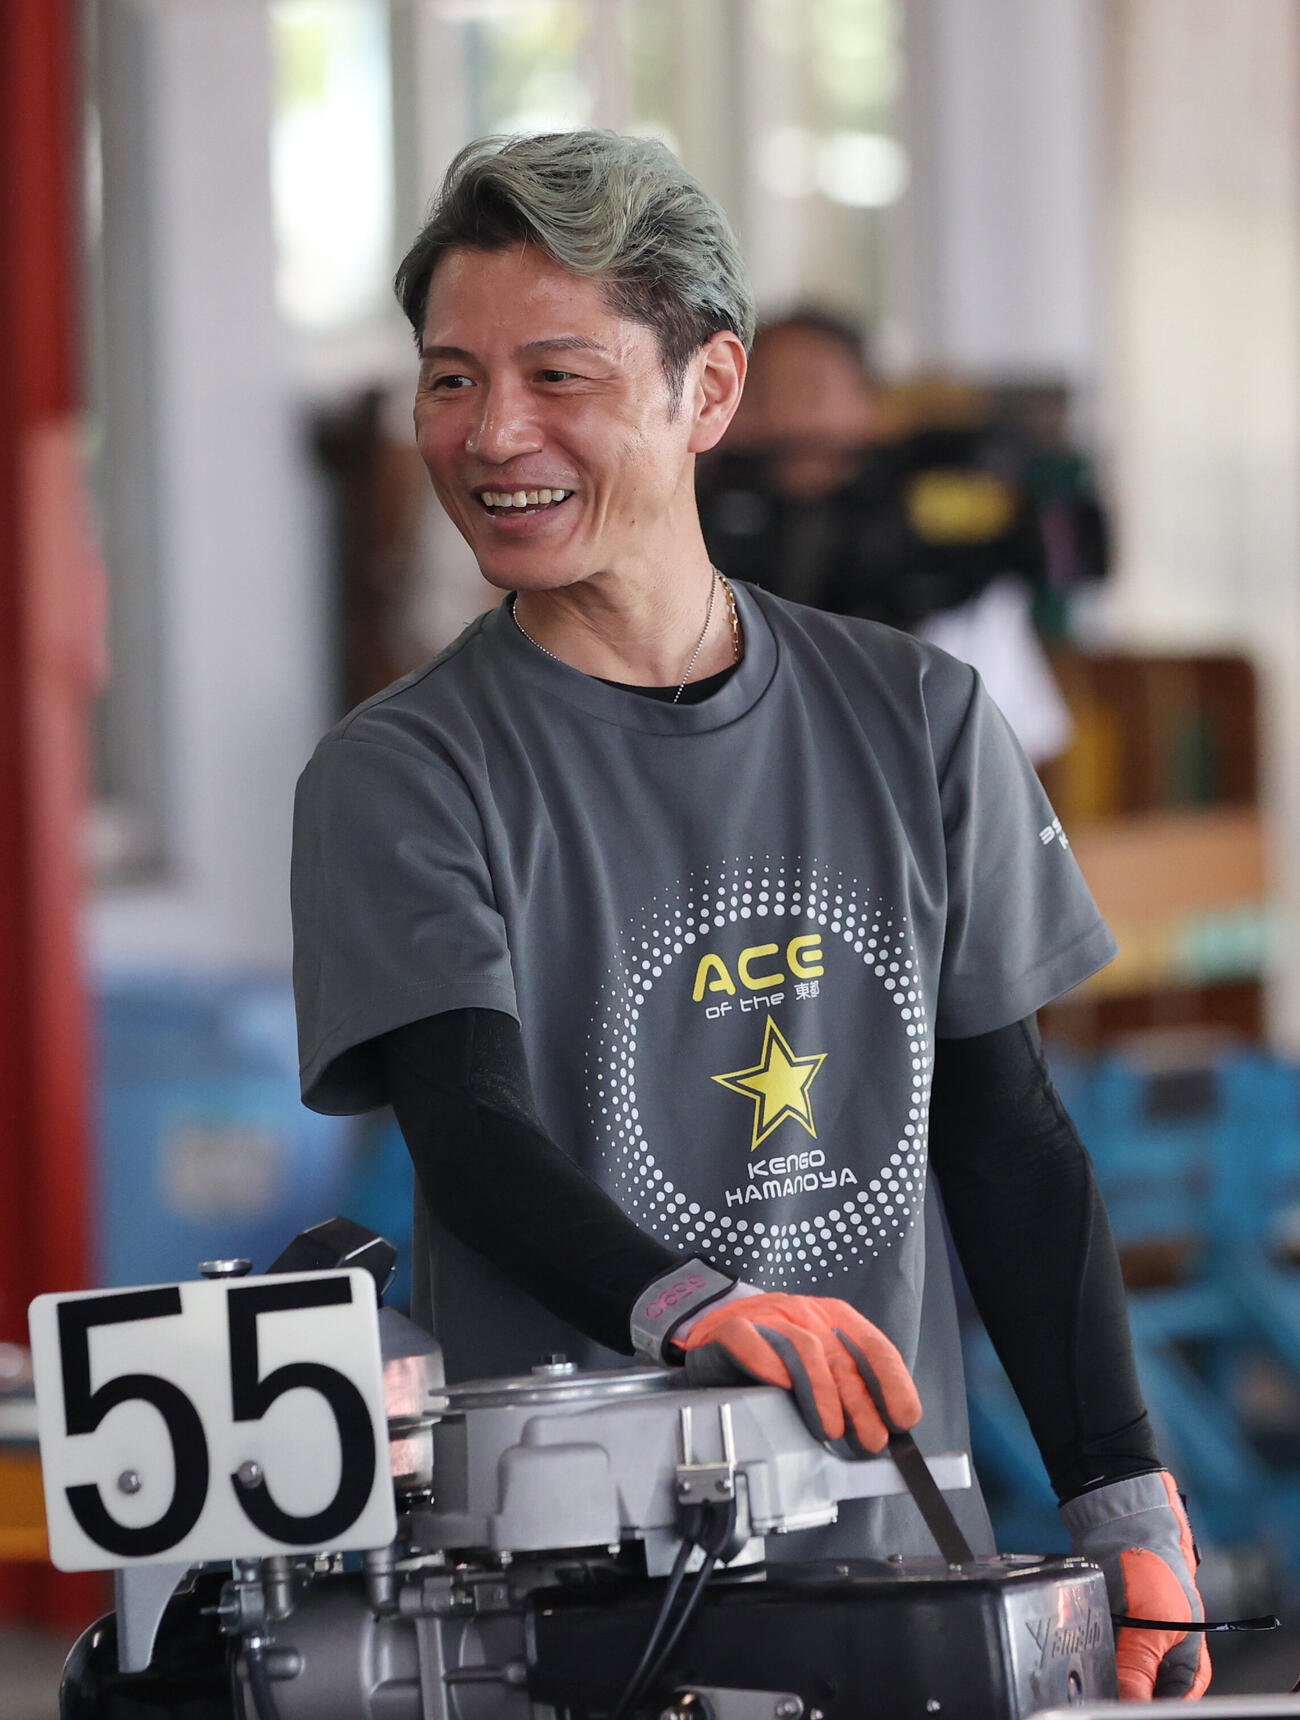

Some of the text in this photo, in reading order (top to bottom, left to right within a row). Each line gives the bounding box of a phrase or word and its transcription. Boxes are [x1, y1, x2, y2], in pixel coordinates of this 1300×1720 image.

[692, 933, 825, 1002] ACE
[705, 980, 820, 1019] of the 東都
[747, 1149, 826, 1180] KENGO
[724, 1167, 858, 1208] HAMANOYA
[57, 1276, 376, 1557] 55
